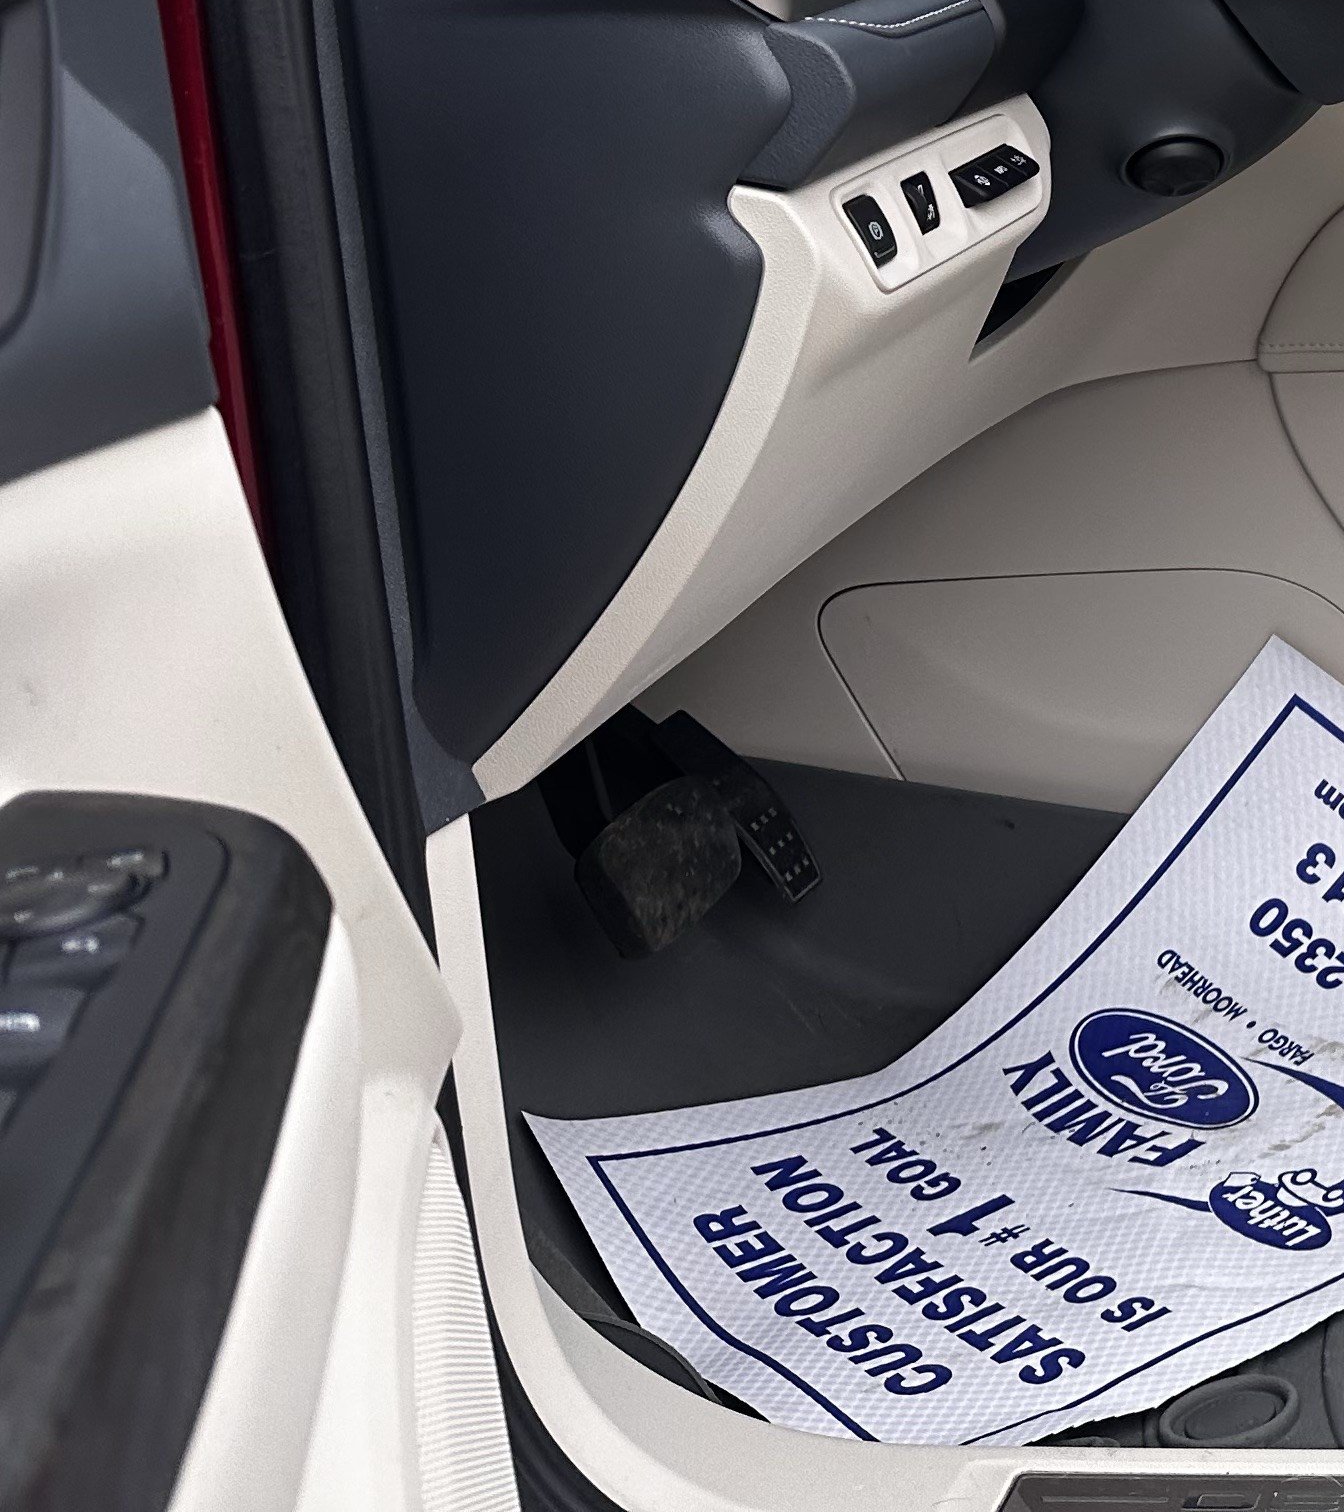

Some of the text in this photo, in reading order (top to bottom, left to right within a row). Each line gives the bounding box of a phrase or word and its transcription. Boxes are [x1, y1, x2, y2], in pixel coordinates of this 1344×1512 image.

[1157, 950, 1315, 1066] FARGO MOORHEAD
[1004, 1051, 1206, 1167] FAMILY
[1101, 1032, 1227, 1117] Ford
[849, 1127, 961, 1201] GOAL
[1221, 1182, 1319, 1247] Luther
[693, 1205, 952, 1395] CUSTOMER
[751, 1155, 1086, 1384] SATISFACTION
[1010, 1239, 1116, 1304] OUR
[1101, 1297, 1172, 1332] IS
